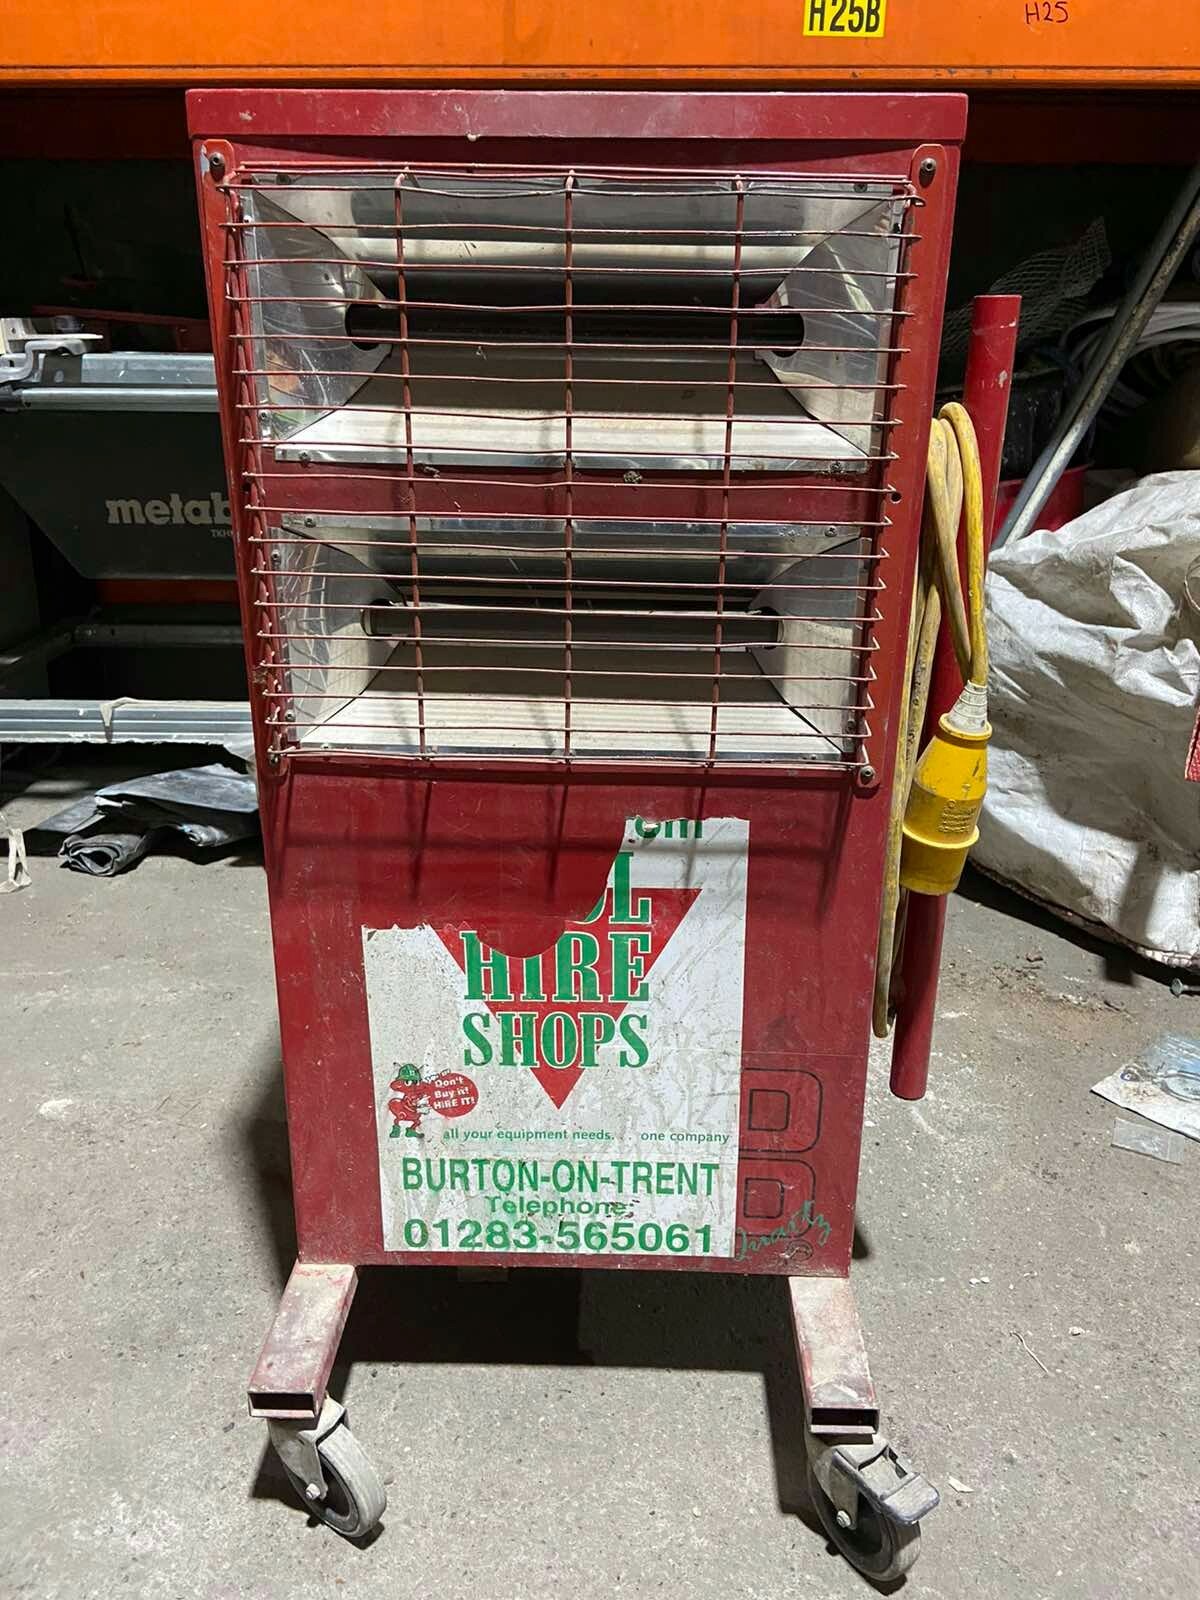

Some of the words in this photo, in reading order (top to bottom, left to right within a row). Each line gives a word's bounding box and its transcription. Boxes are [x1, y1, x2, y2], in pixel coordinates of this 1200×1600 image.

[808, 0, 880, 32] H25B
[1025, 1, 1069, 24] H25
[462, 931, 650, 1002] HIRE
[462, 1011, 649, 1068] SHOPS
[434, 1076, 464, 1088] Don't
[434, 1090, 454, 1099] Buy
[433, 1098, 459, 1109] HIRE
[443, 1128, 459, 1140] all
[463, 1130, 492, 1142] your
[496, 1128, 567, 1142] equipment
[640, 1132, 665, 1141] one
[670, 1132, 729, 1145] company
[403, 1157, 720, 1196] BURTON-ON-TRENT
[404, 1218, 712, 1253] 01283-565061
